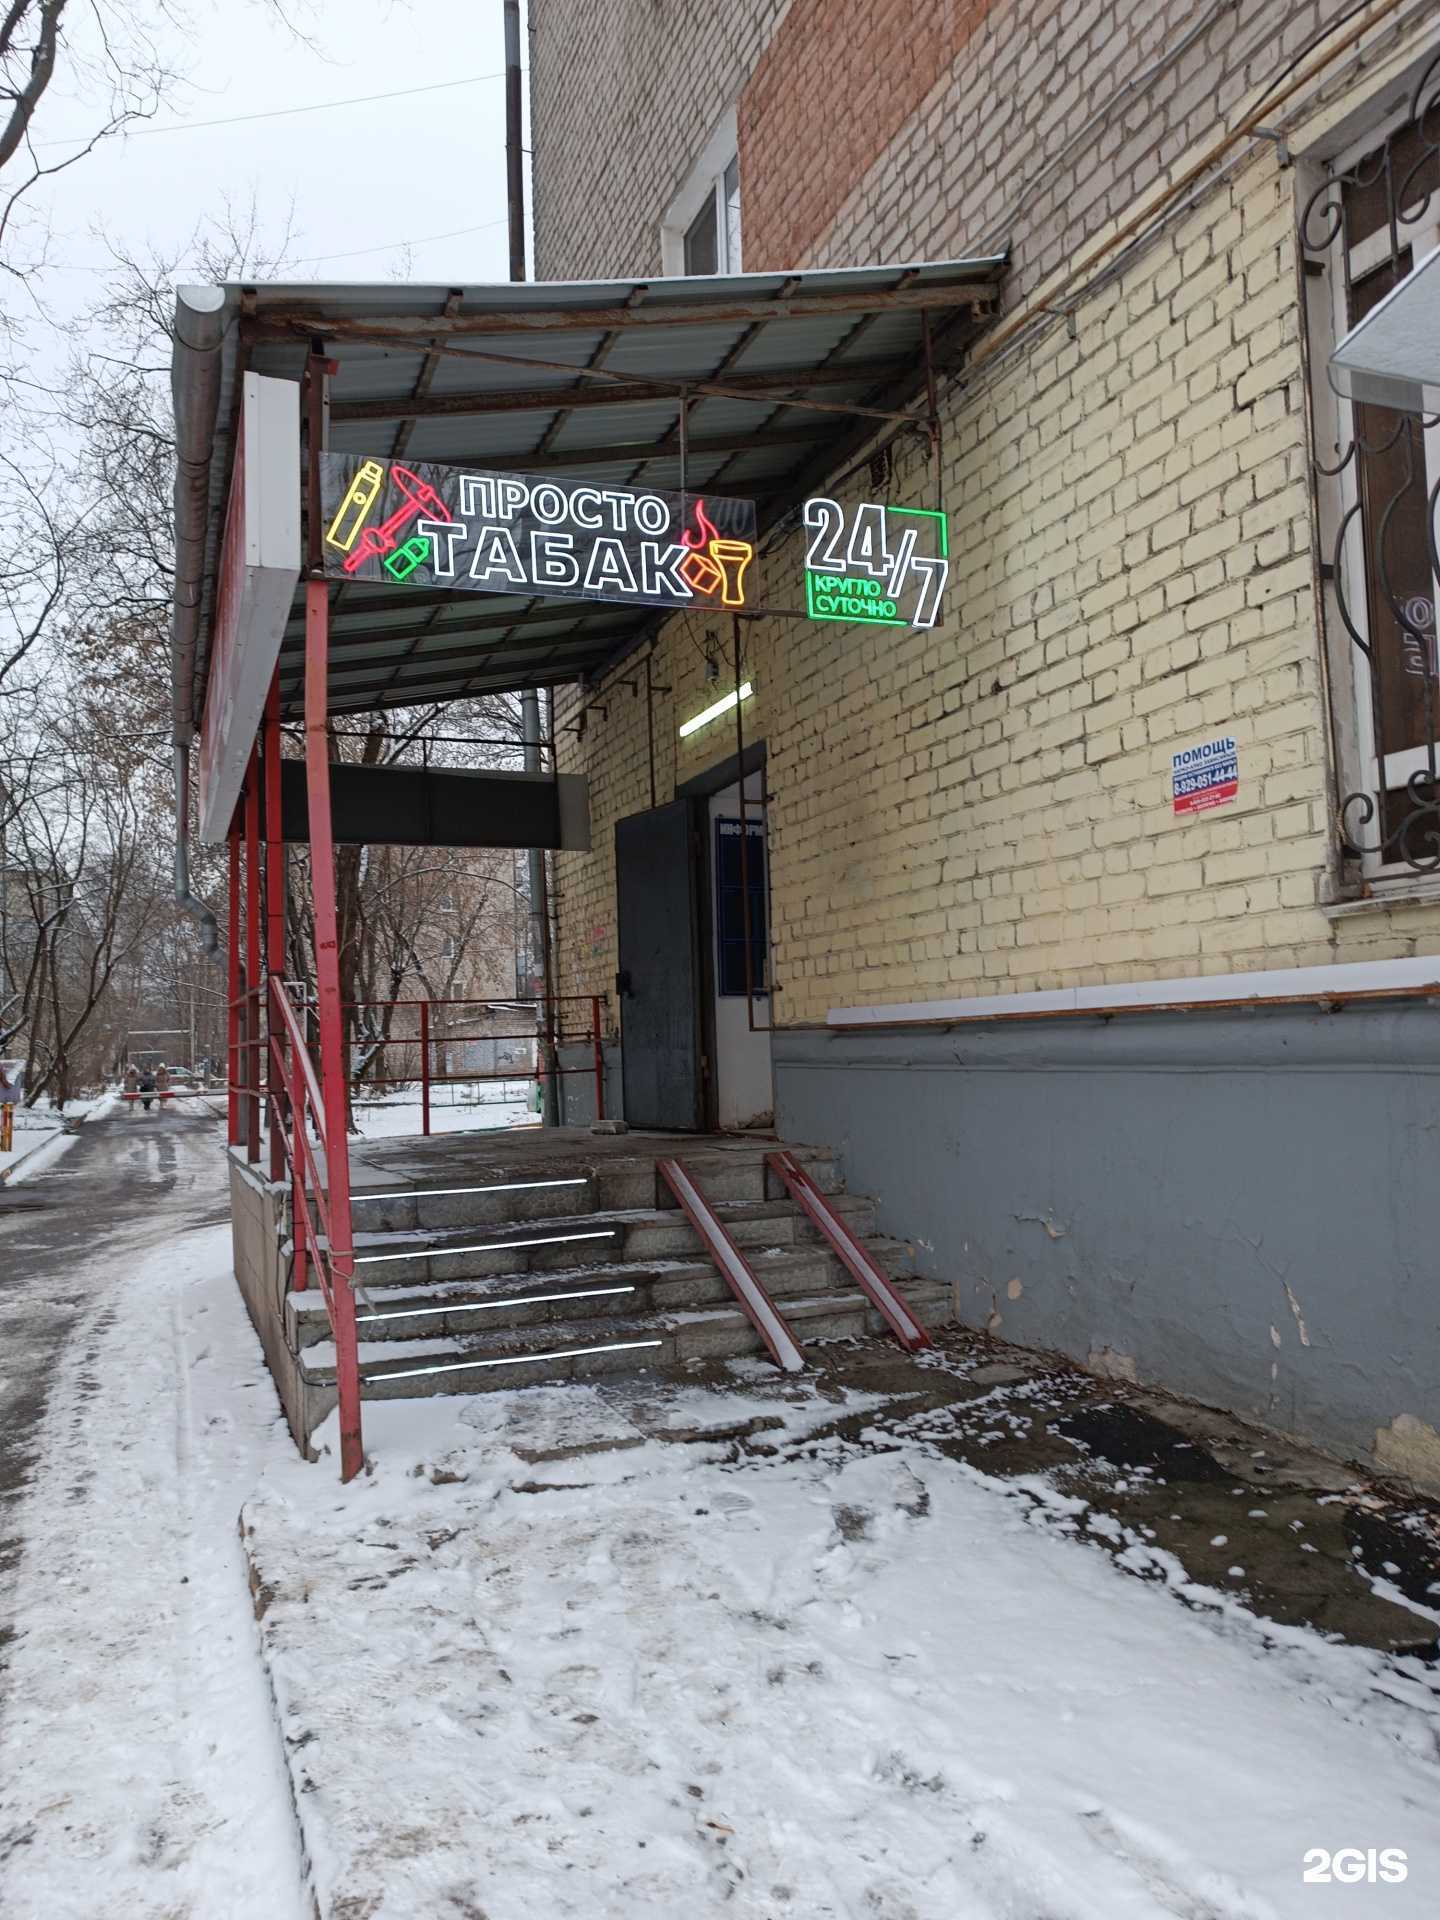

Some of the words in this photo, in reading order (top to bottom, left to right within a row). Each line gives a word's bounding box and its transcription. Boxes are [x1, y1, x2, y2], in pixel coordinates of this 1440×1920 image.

[459, 475, 671, 536] ПРОСТО
[417, 519, 693, 598] ТАБАК
[804, 498, 949, 628] 24/7
[815, 575, 881, 597] КРУГЛО
[816, 595, 897, 617] СУТОЧНО
[1173, 738, 1235, 768] ПОМОЩЬ
